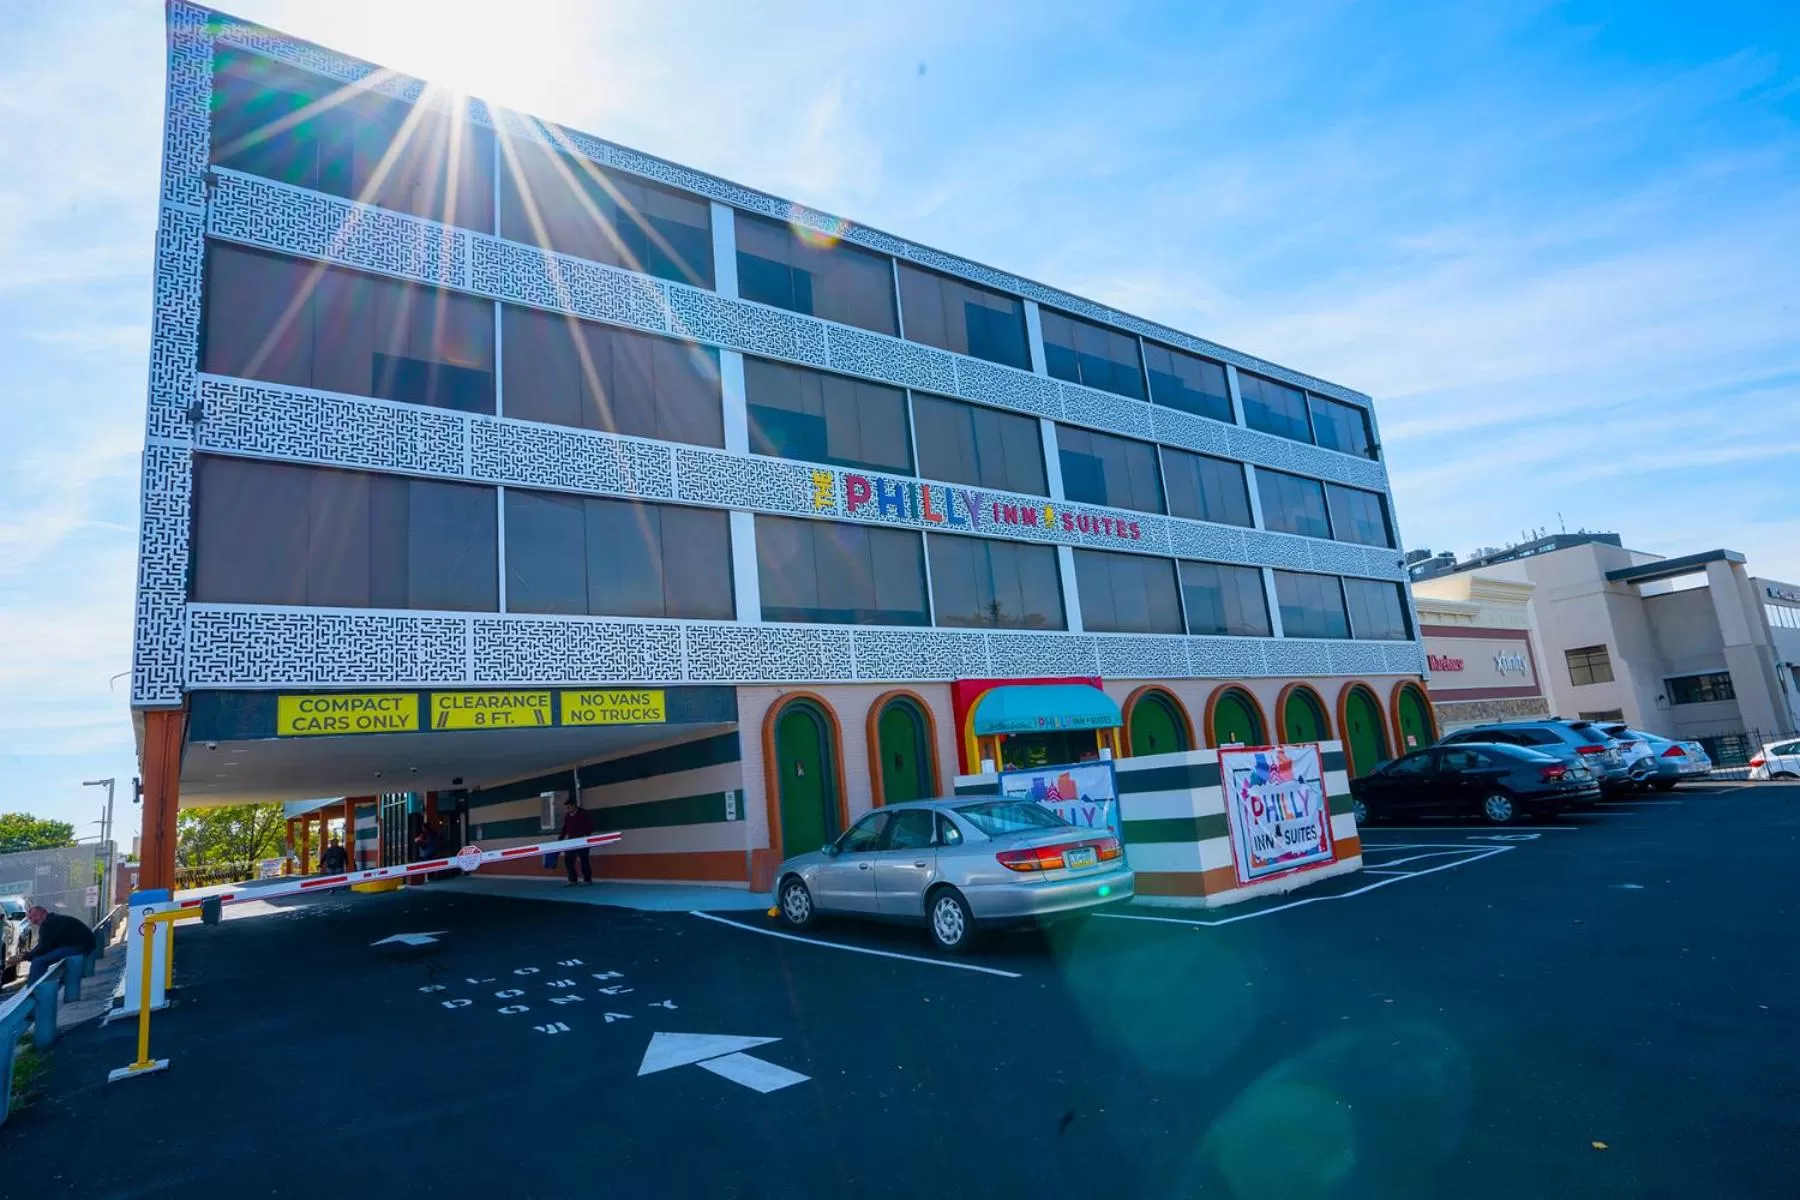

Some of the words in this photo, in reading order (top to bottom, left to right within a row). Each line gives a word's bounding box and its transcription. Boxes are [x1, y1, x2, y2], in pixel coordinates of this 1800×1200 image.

[846, 474, 984, 529] PHILLY
[992, 502, 1037, 527] INN
[1062, 512, 1141, 540] SUITES
[299, 697, 402, 713] COMPACT
[439, 695, 548, 709] CLEARANCE
[580, 694, 605, 706] NO
[609, 693, 651, 705] VANS
[292, 715, 350, 731] CARS
[356, 713, 410, 729] ONLY
[474, 711, 486, 725] 8
[491, 711, 515, 724] FT.
[571, 709, 596, 721] NO
[600, 707, 660, 721] TRUCKS
[1250, 789, 1310, 825] PHILLY
[1253, 833, 1275, 852] INN
[1284, 825, 1318, 846] SUITES
